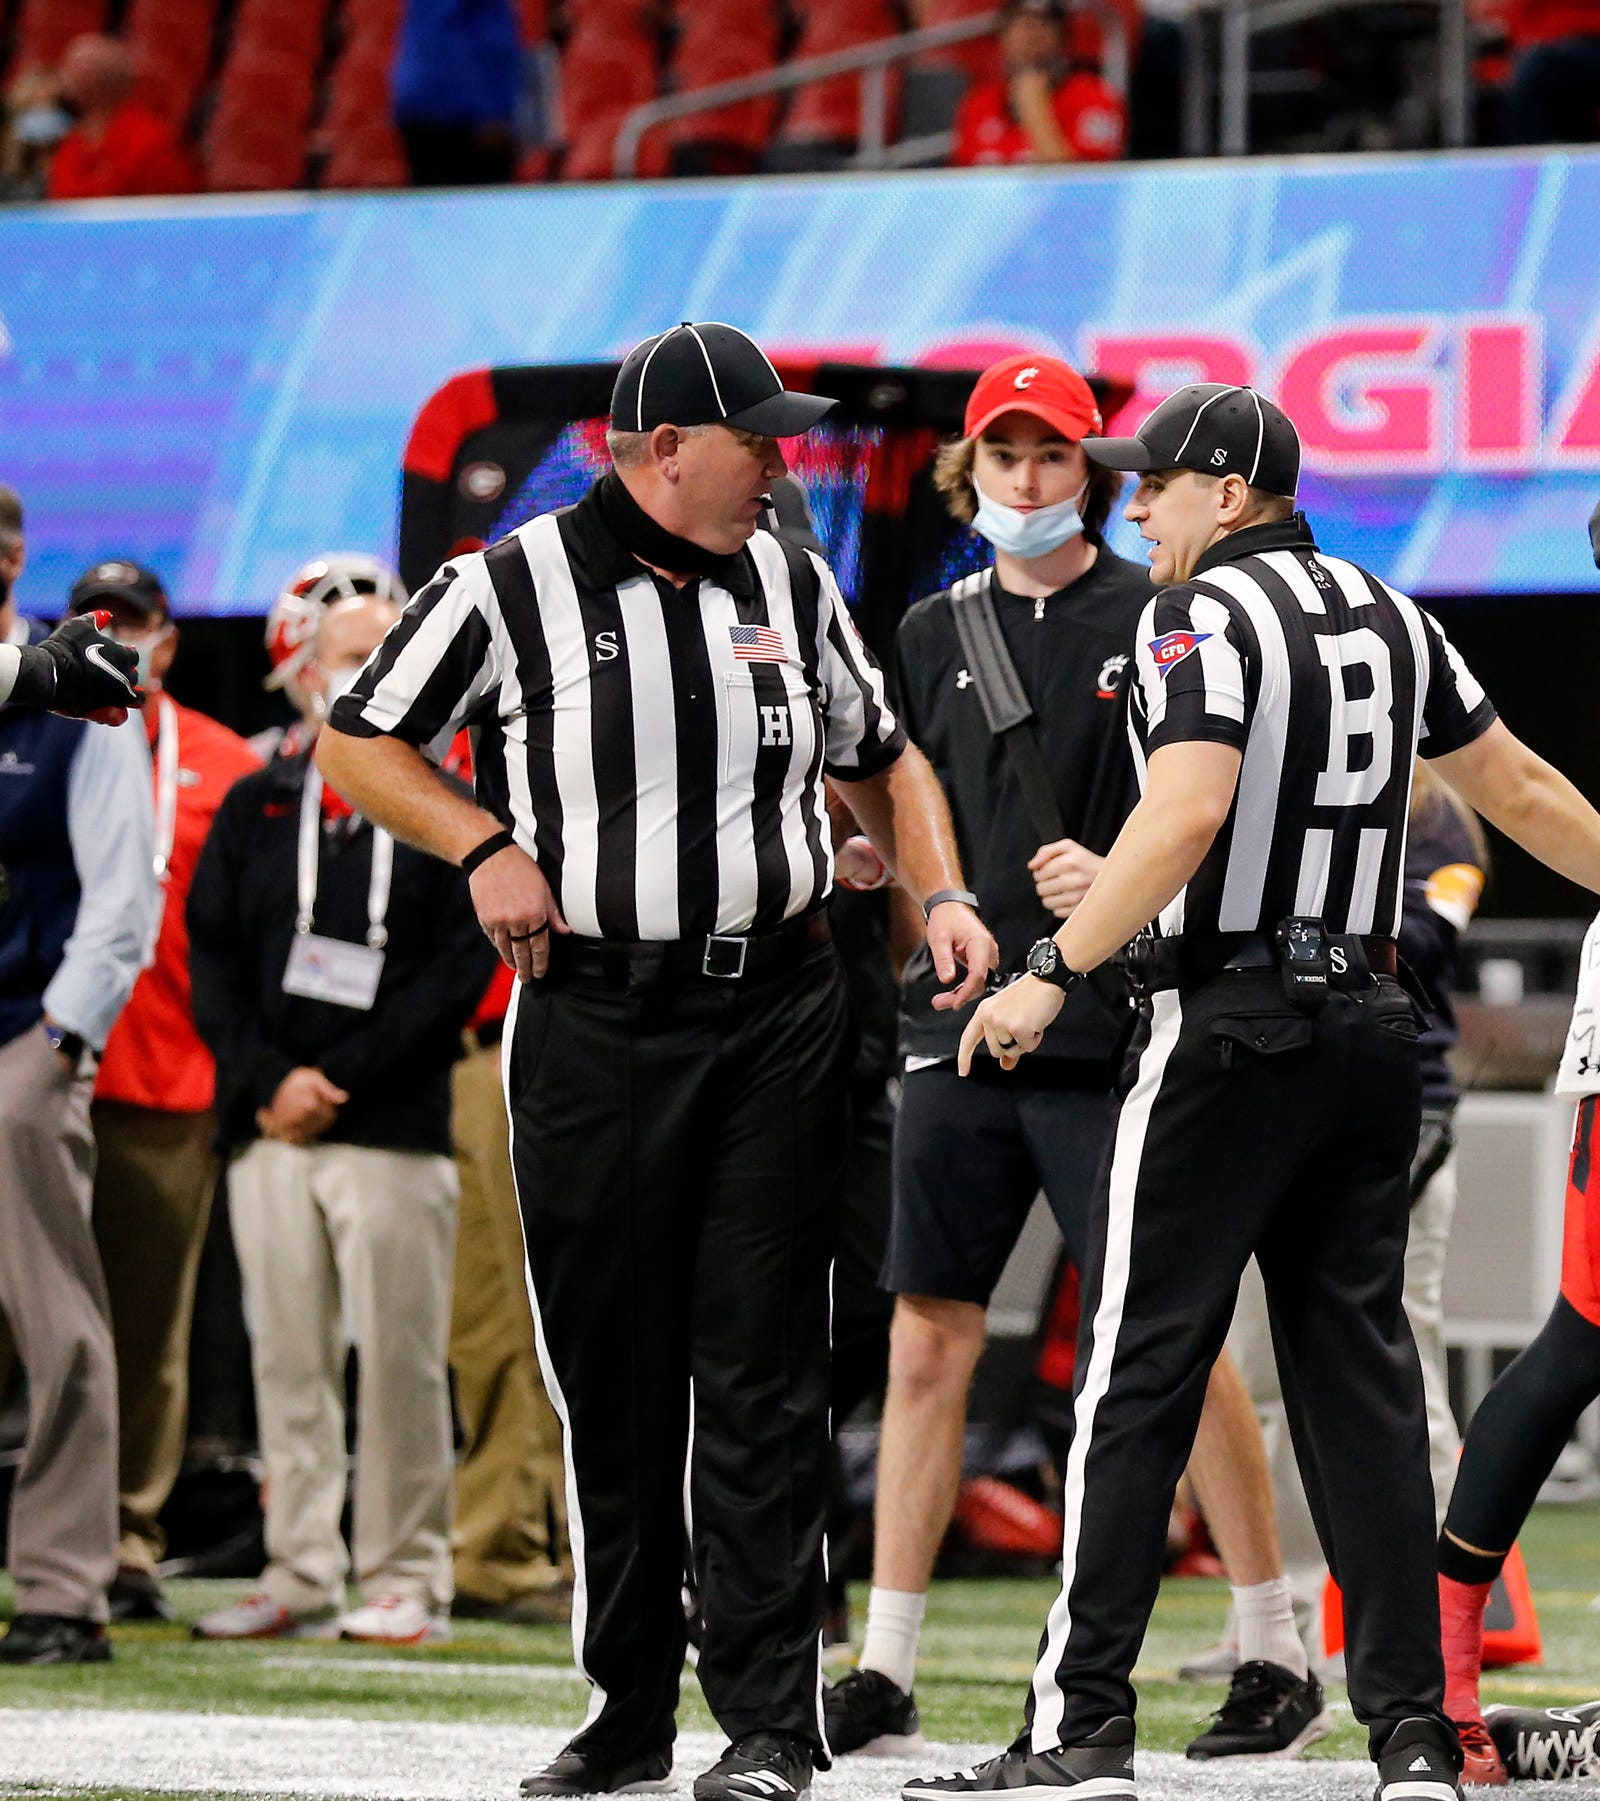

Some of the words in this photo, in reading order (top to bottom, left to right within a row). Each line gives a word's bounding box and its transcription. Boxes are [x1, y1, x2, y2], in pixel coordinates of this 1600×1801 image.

[594, 631, 620, 662] S
[759, 704, 791, 746] H
[1313, 626, 1395, 807] B
[1329, 946, 1349, 974] S
